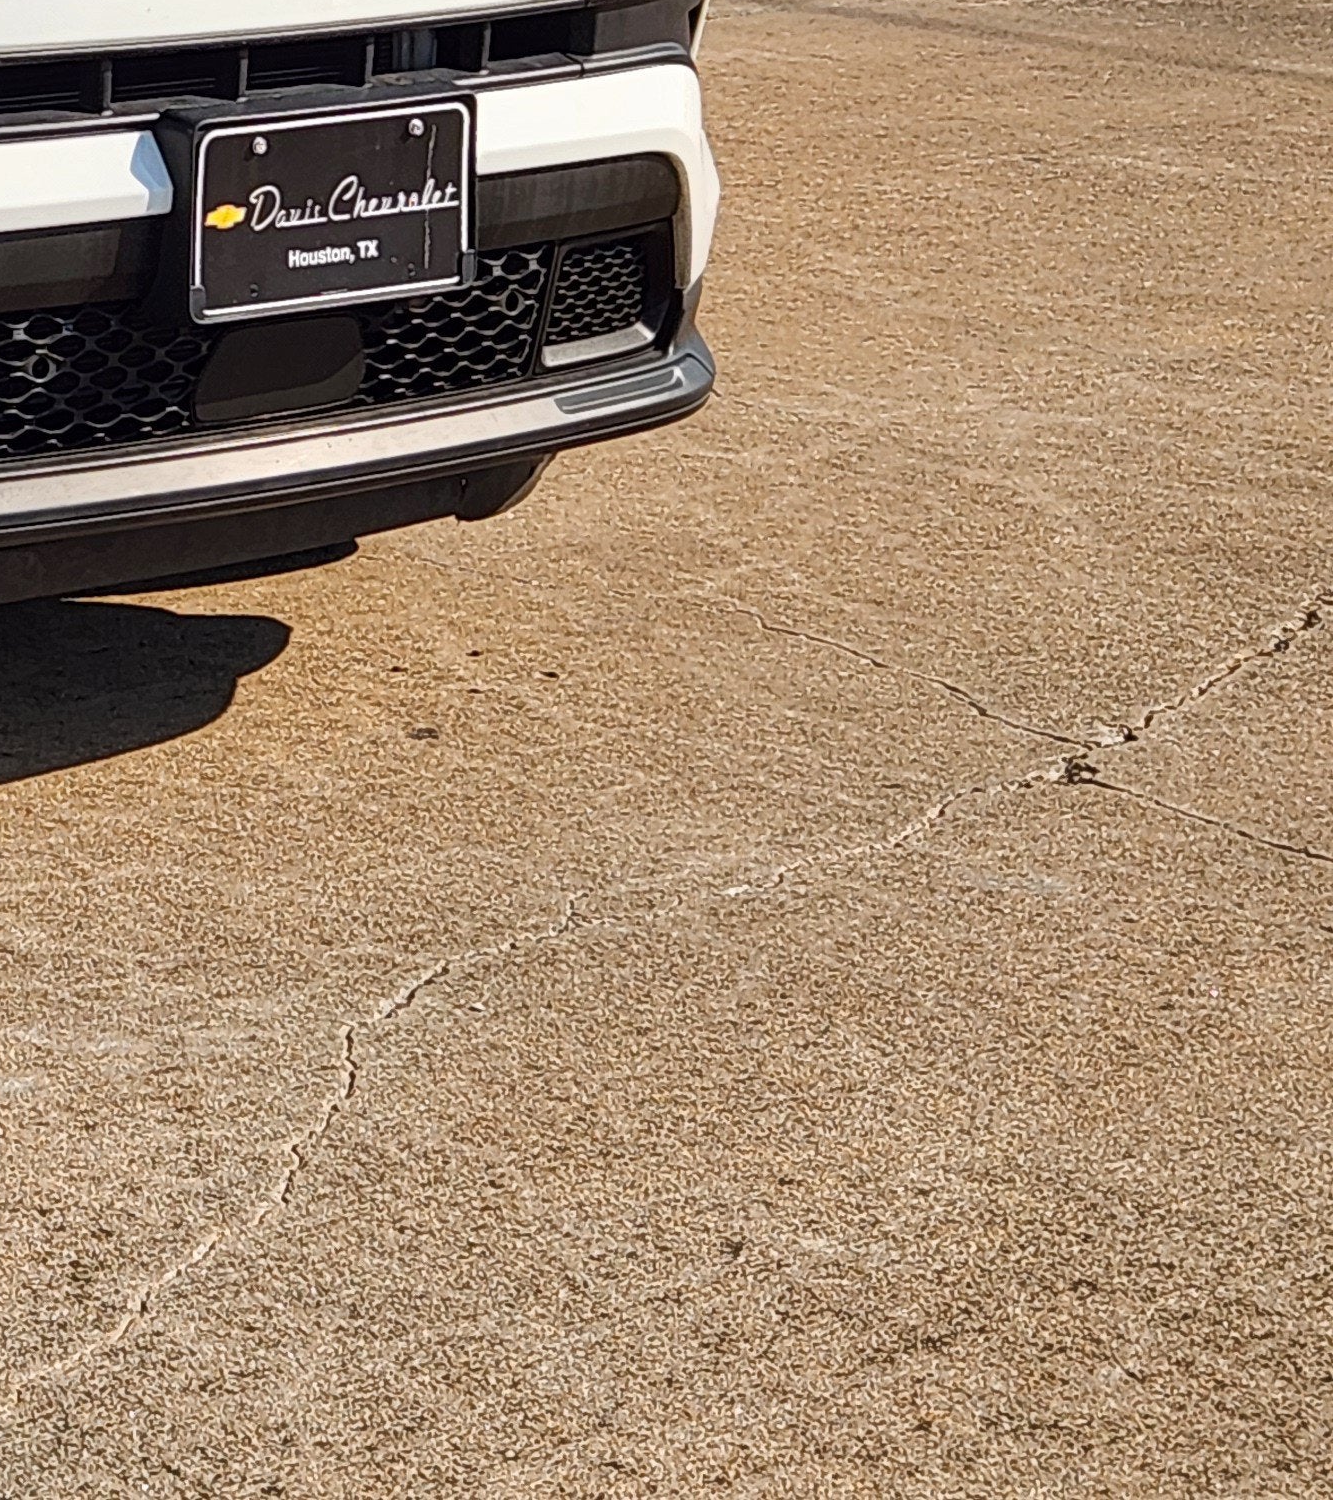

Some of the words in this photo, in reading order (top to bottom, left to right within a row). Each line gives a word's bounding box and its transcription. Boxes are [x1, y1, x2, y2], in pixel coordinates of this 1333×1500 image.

[249, 185, 327, 231] Davis
[328, 175, 459, 220] Chevrolet
[288, 245, 355, 269] Houston,
[356, 239, 379, 259] TX
